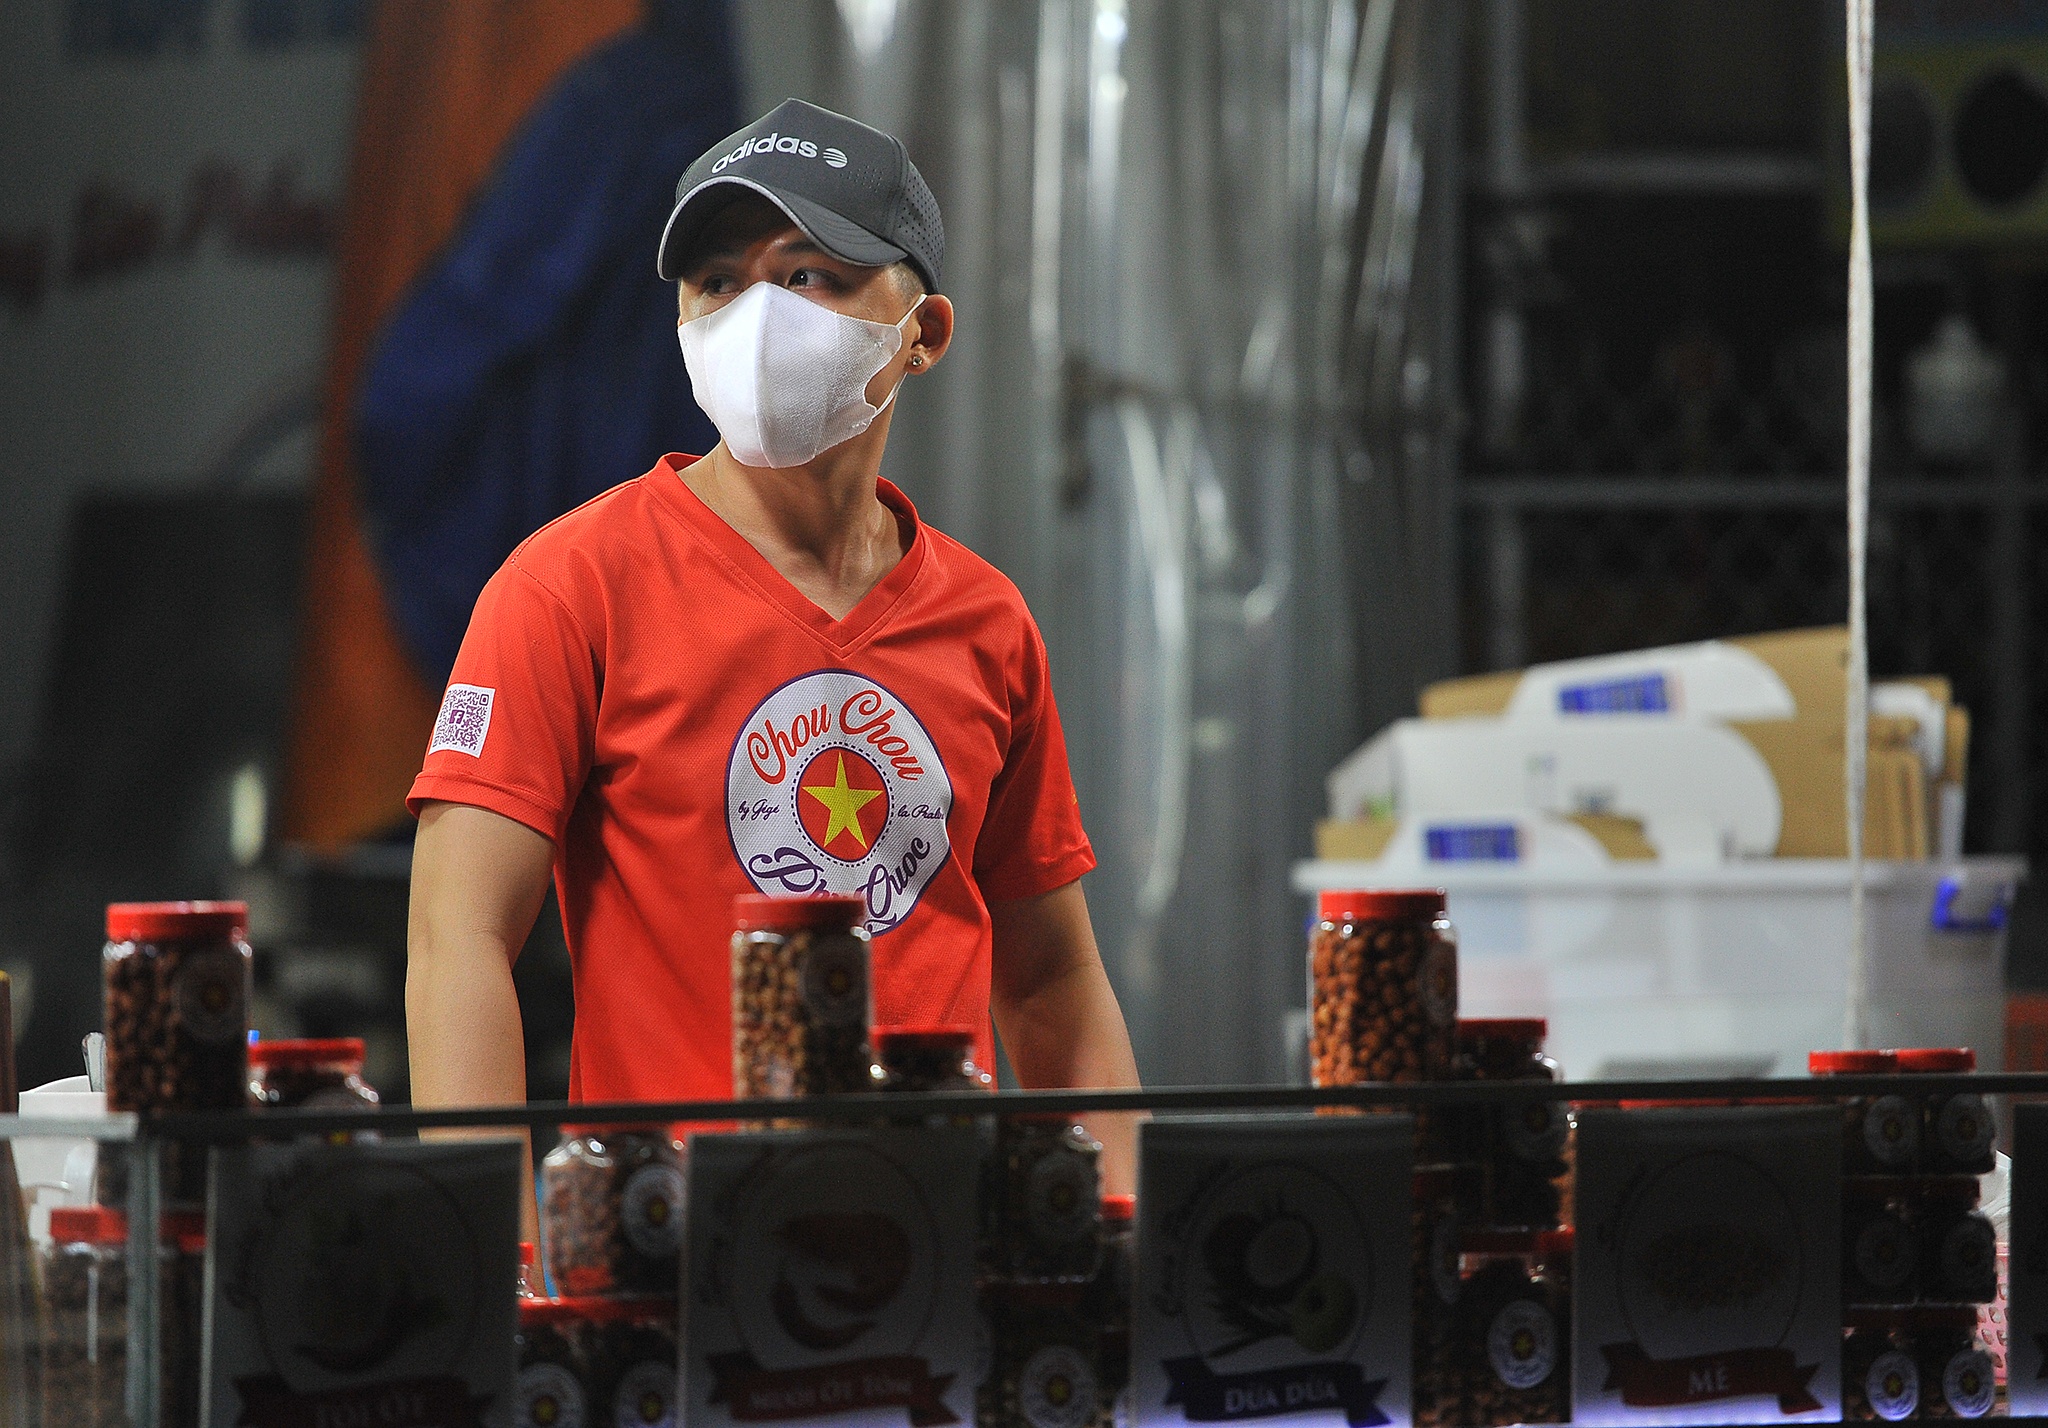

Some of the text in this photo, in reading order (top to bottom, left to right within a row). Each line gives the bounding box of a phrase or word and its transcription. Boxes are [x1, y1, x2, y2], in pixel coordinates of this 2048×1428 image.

[711, 132, 818, 174] adidas
[747, 689, 925, 785] Chou Chou
[737, 800, 750, 821] by
[897, 804, 911, 818] la
